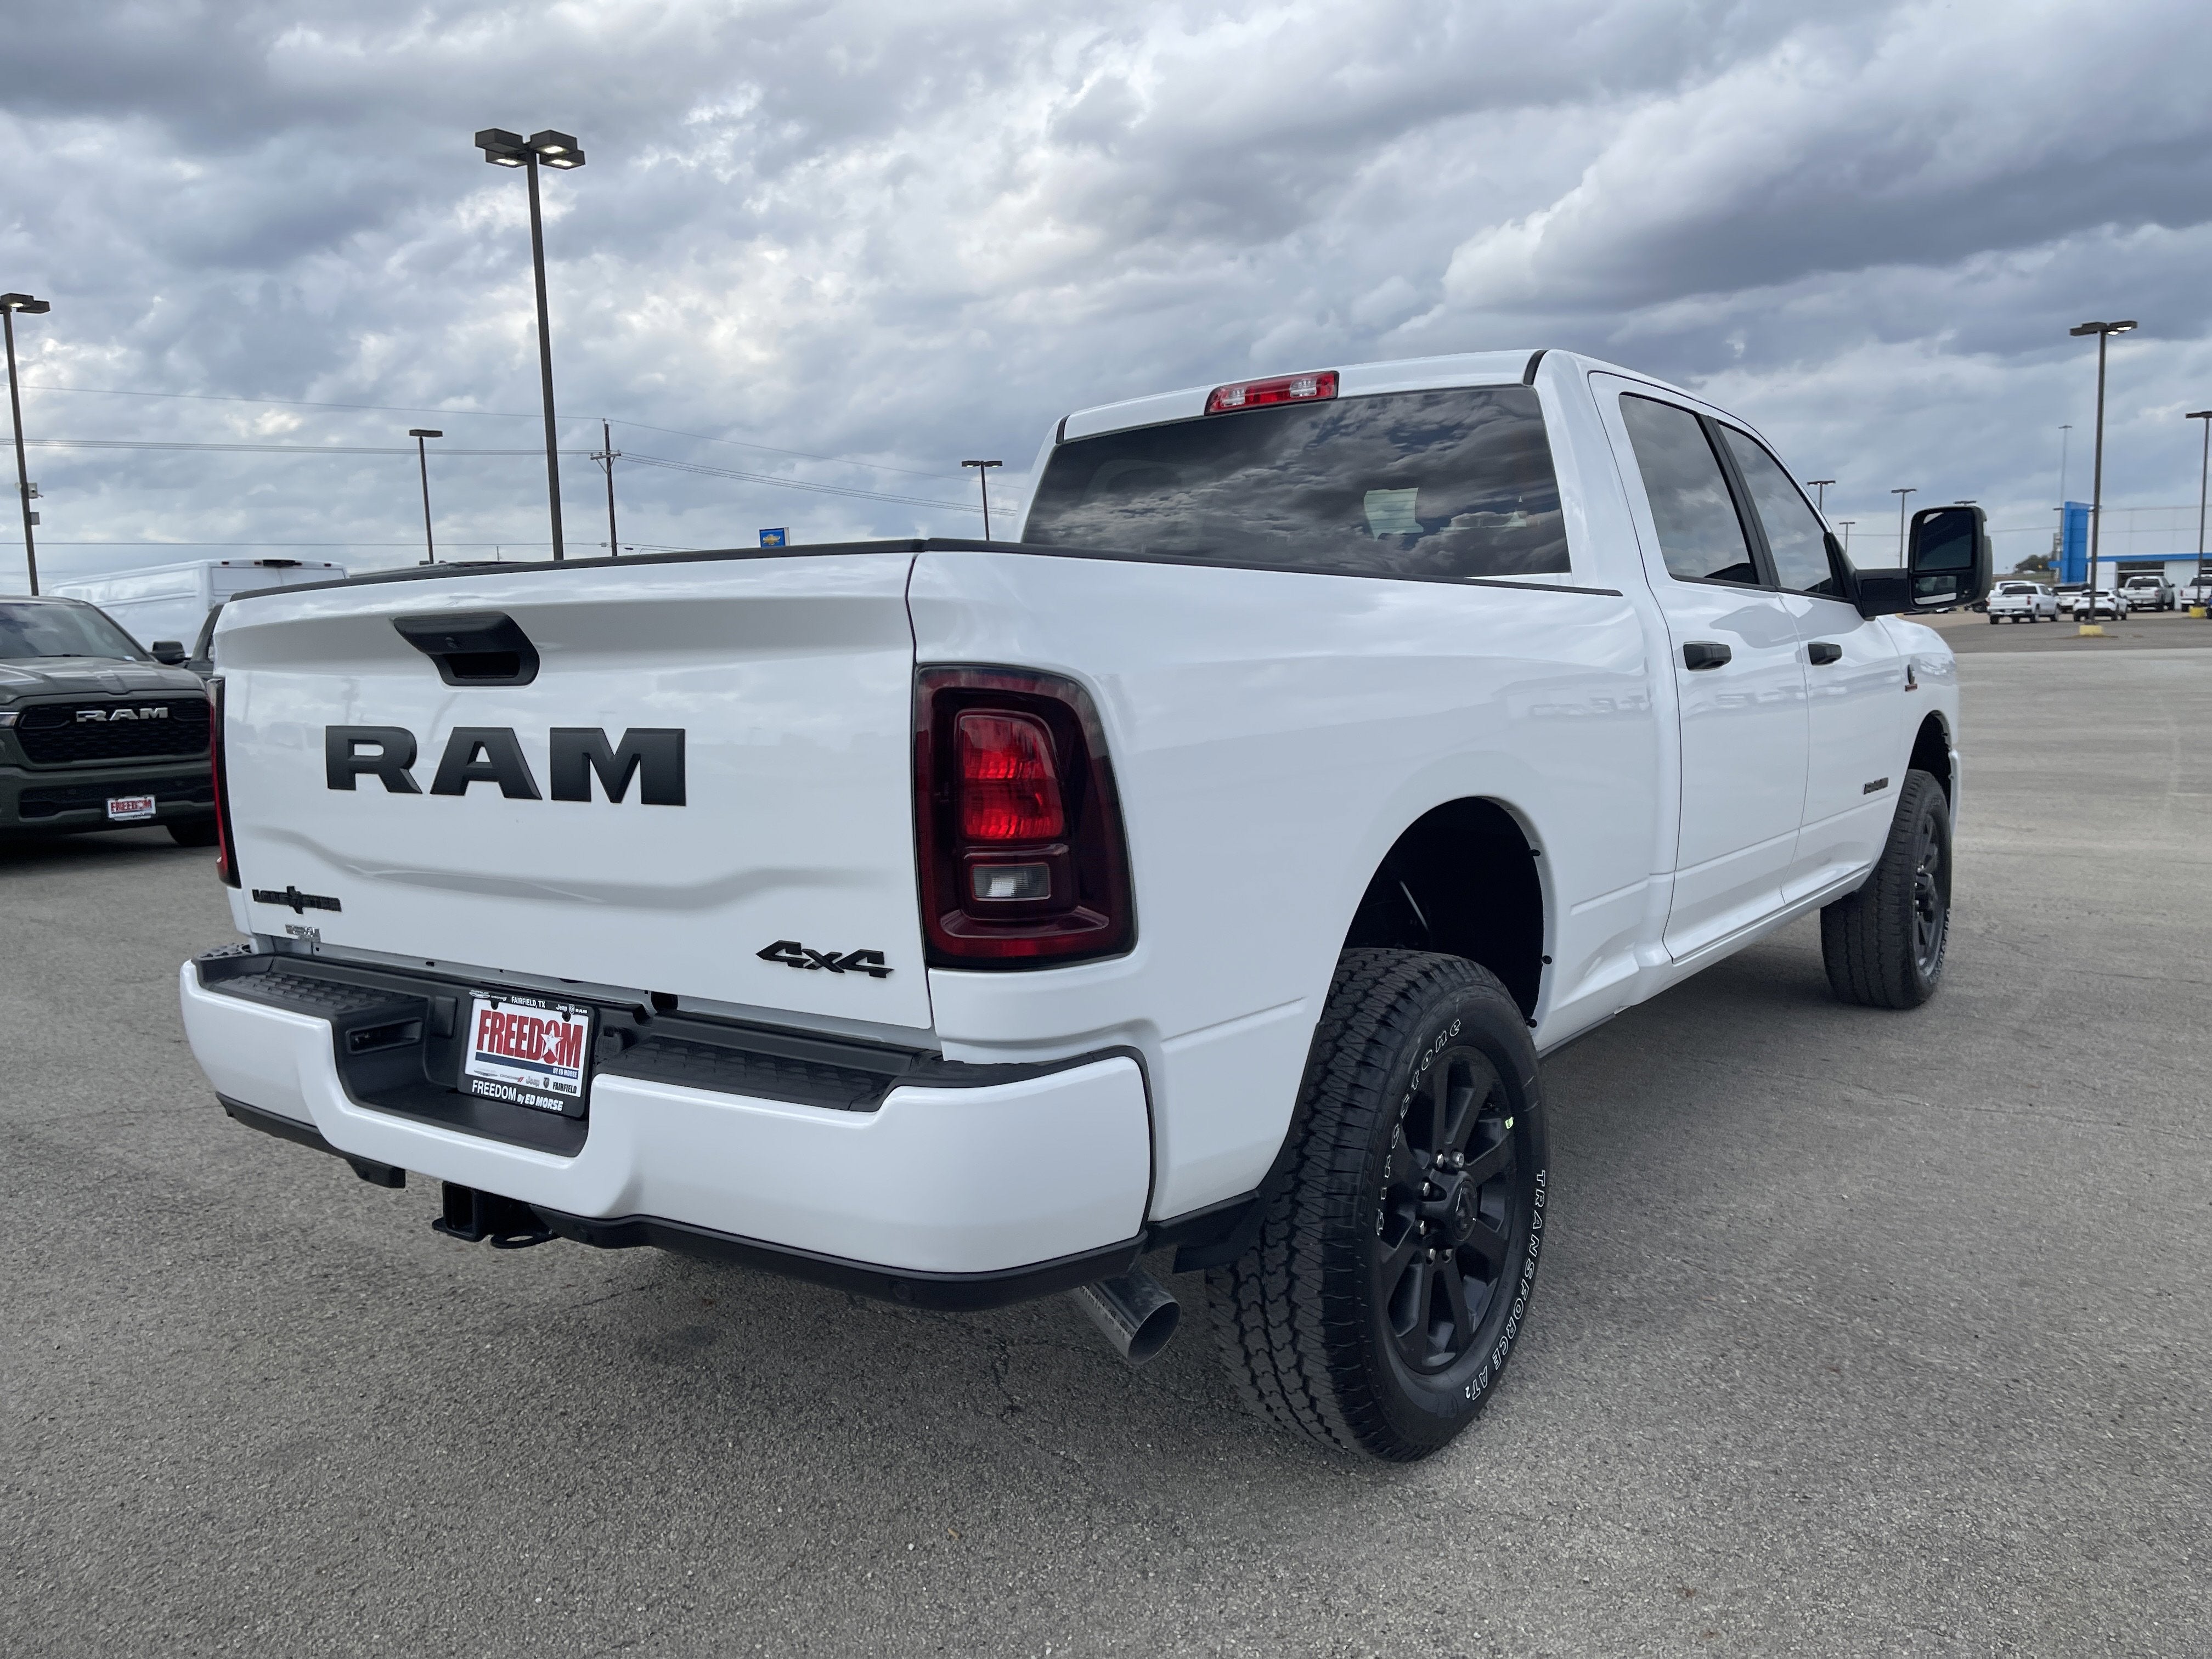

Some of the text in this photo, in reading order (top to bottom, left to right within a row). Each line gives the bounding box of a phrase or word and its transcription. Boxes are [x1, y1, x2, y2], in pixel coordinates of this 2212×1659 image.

[76, 707, 168, 723] RAM
[326, 725, 686, 806] RAM
[511, 996, 537, 1008] FAIRFIELD,
[538, 1000, 545, 1008] TX
[476, 1009, 584, 1069] FREEDOM
[472, 1080, 517, 1102] FREEDOM
[524, 1093, 535, 1105] ED
[535, 1096, 564, 1111] MORSE
[552, 1081, 577, 1094] FAIRFIELD
[1492, 1170, 1546, 1370] TRANSFORCE
